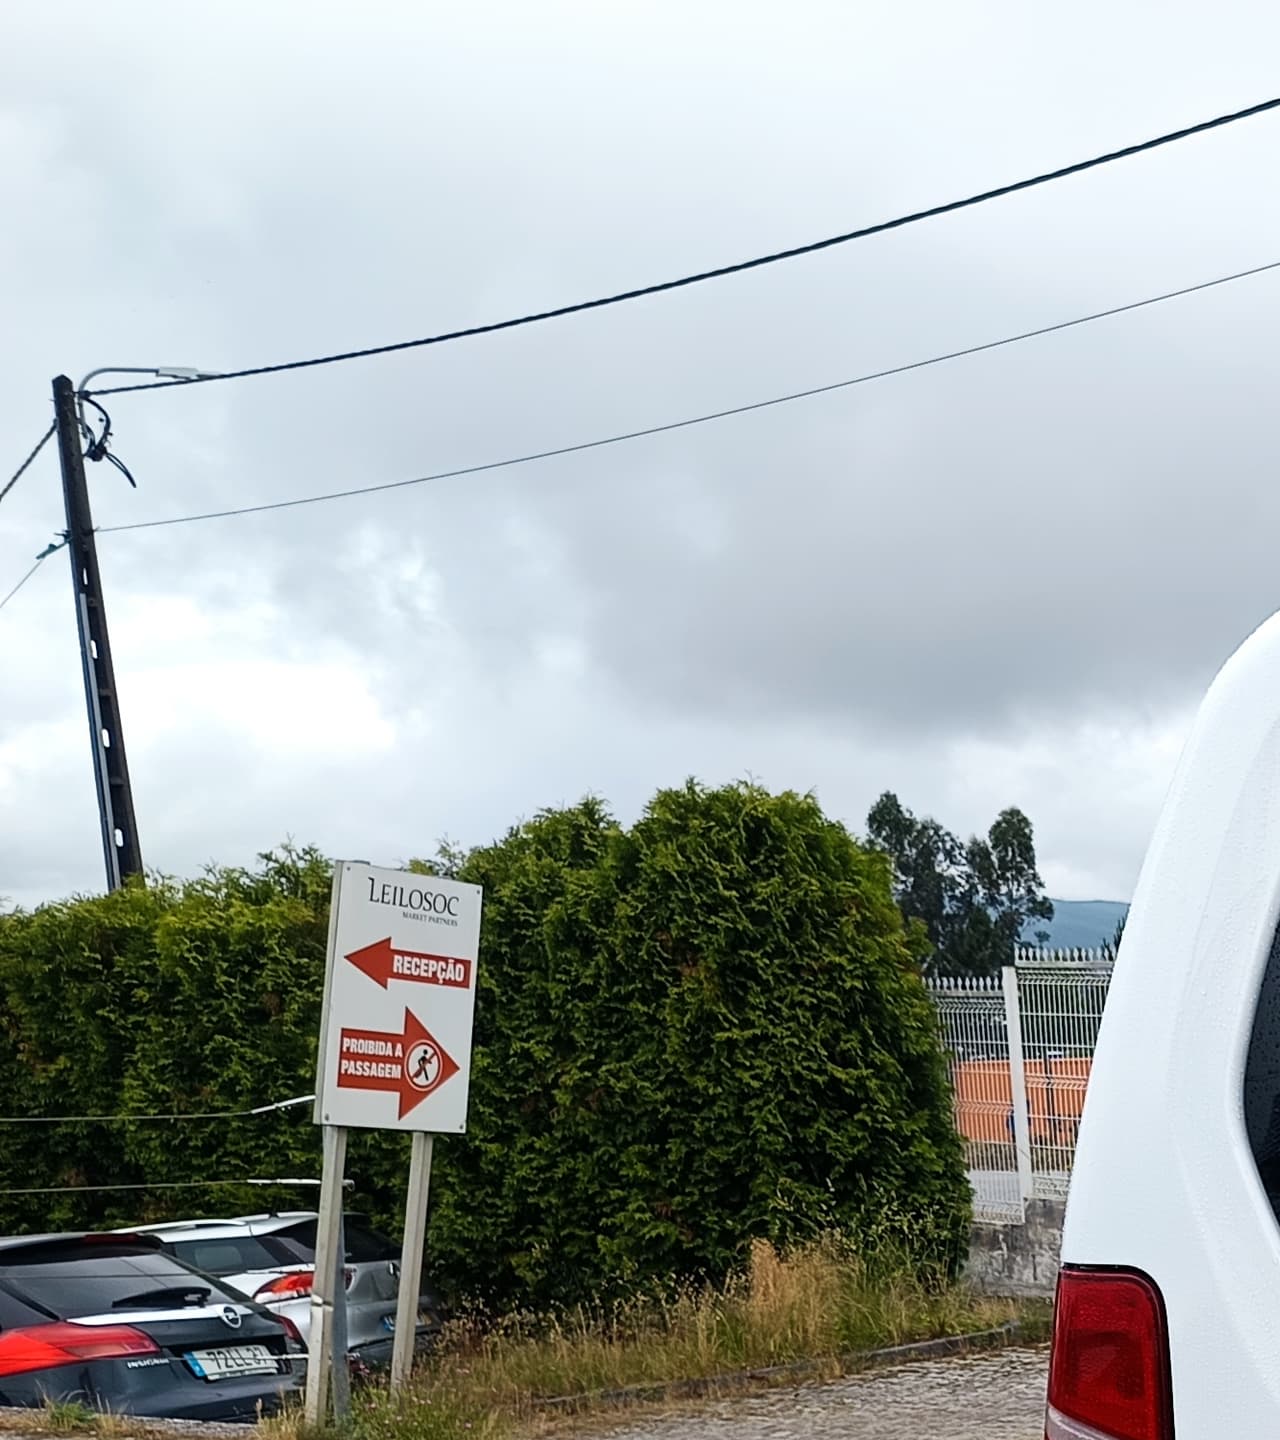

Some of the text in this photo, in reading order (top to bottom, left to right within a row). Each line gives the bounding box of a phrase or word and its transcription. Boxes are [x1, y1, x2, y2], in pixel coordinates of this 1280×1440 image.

[368, 877, 459, 916] LEILOSOC
[393, 955, 465, 984] RECEPÇÃO
[343, 1037, 403, 1058] PROIBIDA A
[341, 1060, 402, 1079] PASSAGEM
